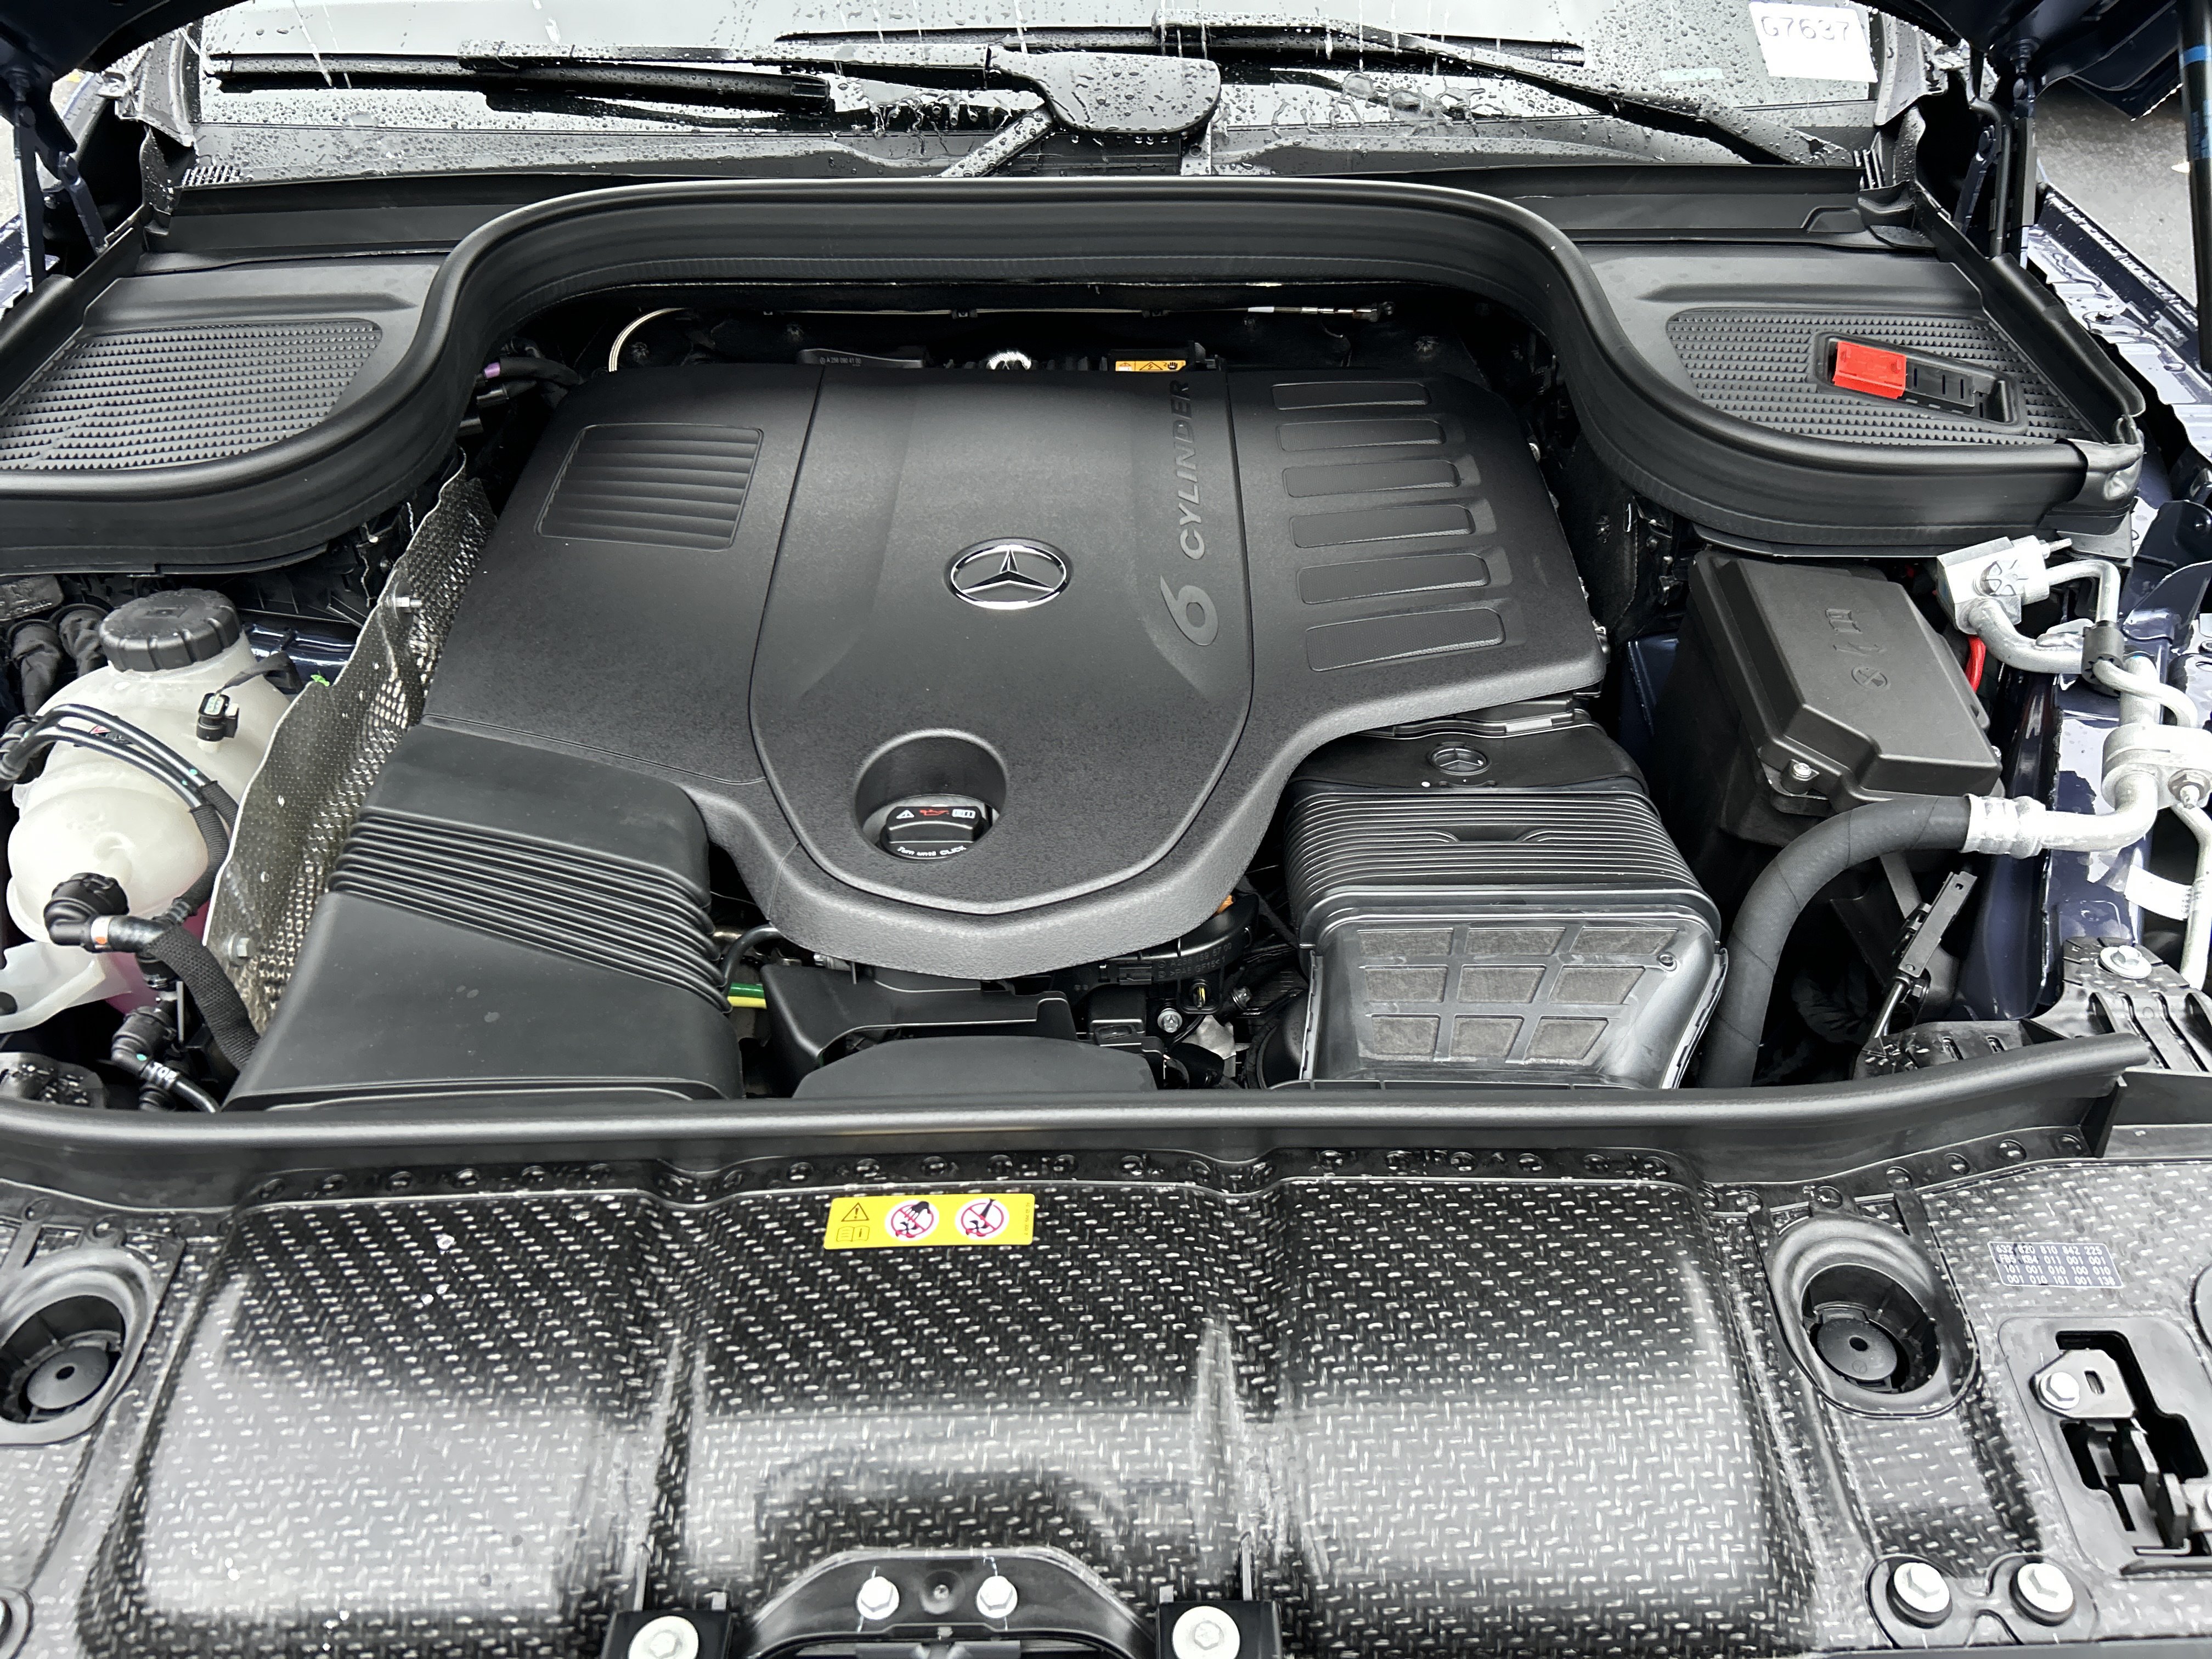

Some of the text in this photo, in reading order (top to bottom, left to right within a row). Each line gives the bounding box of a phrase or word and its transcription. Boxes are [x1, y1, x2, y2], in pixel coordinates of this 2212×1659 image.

[1160, 380, 1219, 646] 6 CYLINDER
[897, 847, 915, 855] Turn
[939, 845, 967, 855] CLICK
[151, 1062, 177, 1080] TOP
[1996, 1245, 2013, 1254] 632
[2040, 1245, 2058, 1254] 810
[2062, 1245, 2080, 1255] 842
[2084, 1246, 2103, 1255] 225
[2044, 1255, 2061, 1265] 011
[2066, 1256, 2084, 1265] 001
[2089, 1256, 2106, 1265] 001
[2004, 1265, 2111, 1275] 101 001 010 100 010
[2007, 1274, 2024, 1283] 001
[2029, 1274, 2048, 1284] 010
[2053, 1276, 2069, 1285] 101
[2074, 1276, 2092, 1285] 001
